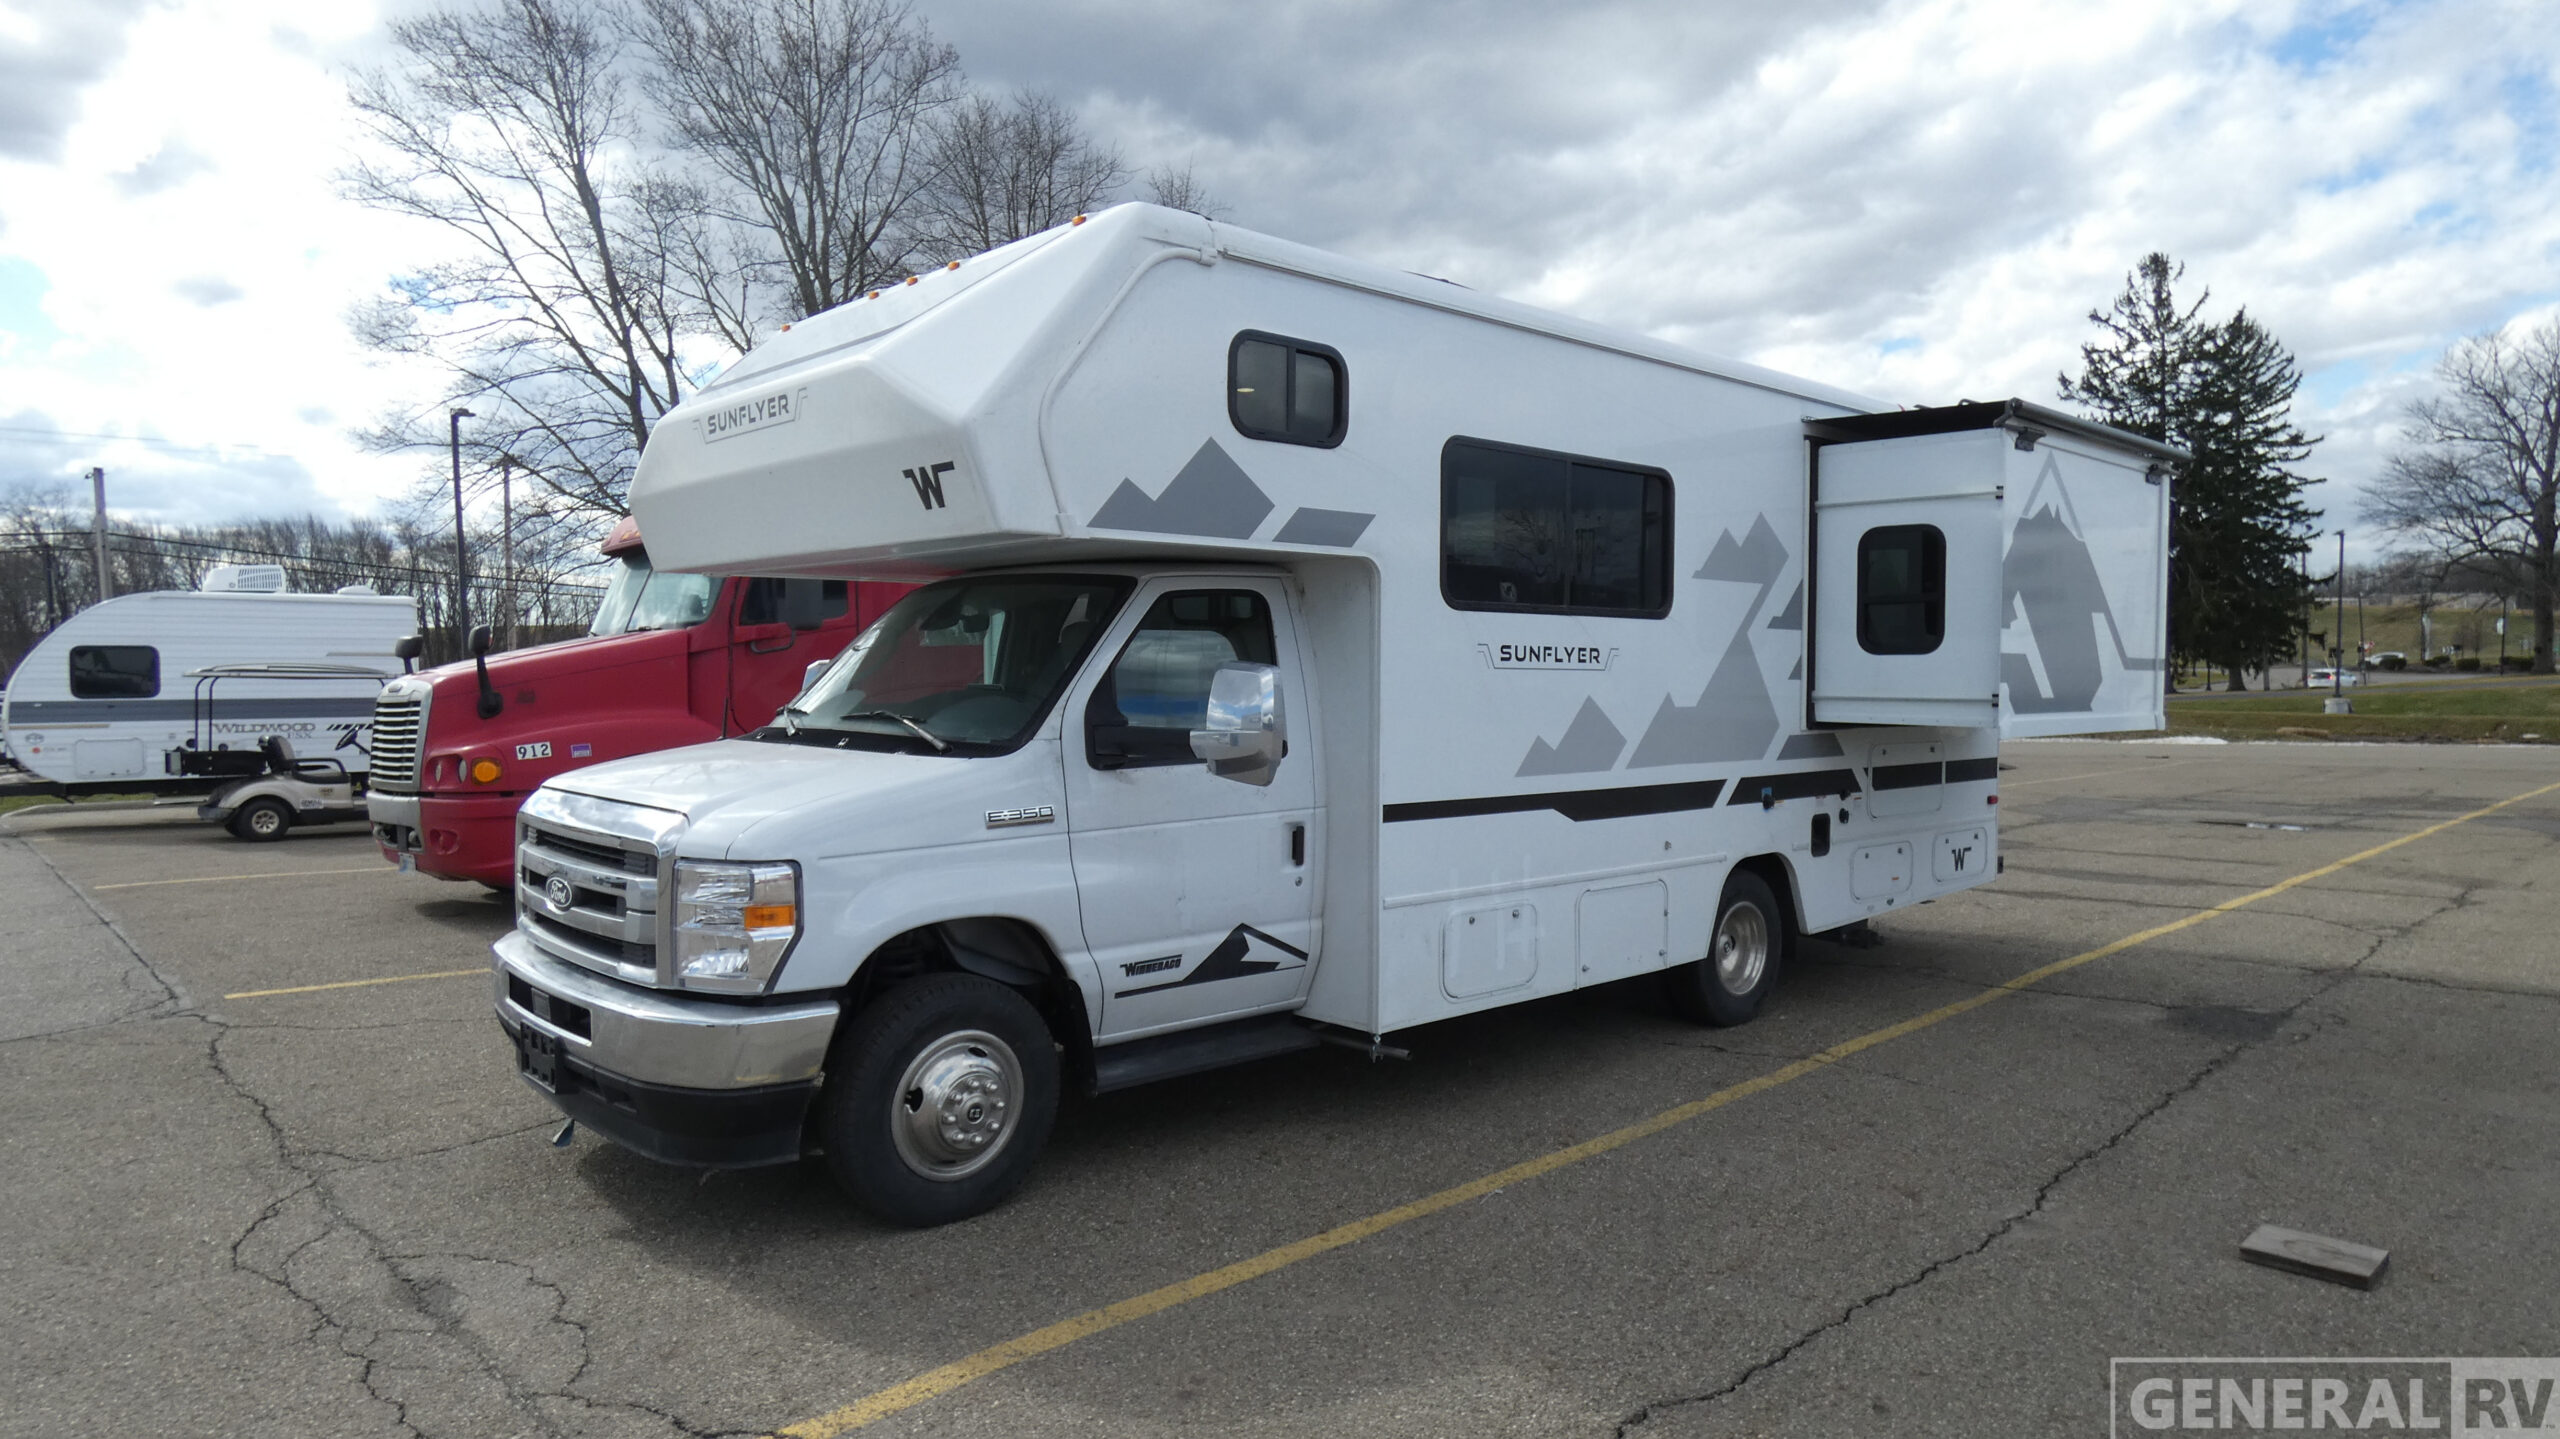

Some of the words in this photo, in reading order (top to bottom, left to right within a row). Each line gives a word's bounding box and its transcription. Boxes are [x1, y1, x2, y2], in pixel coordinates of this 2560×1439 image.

[707, 394, 790, 435] SUNFLYER
[1500, 644, 1601, 664] SUNFLYER
[212, 723, 316, 734] WILDWOOD
[518, 743, 550, 759] 912
